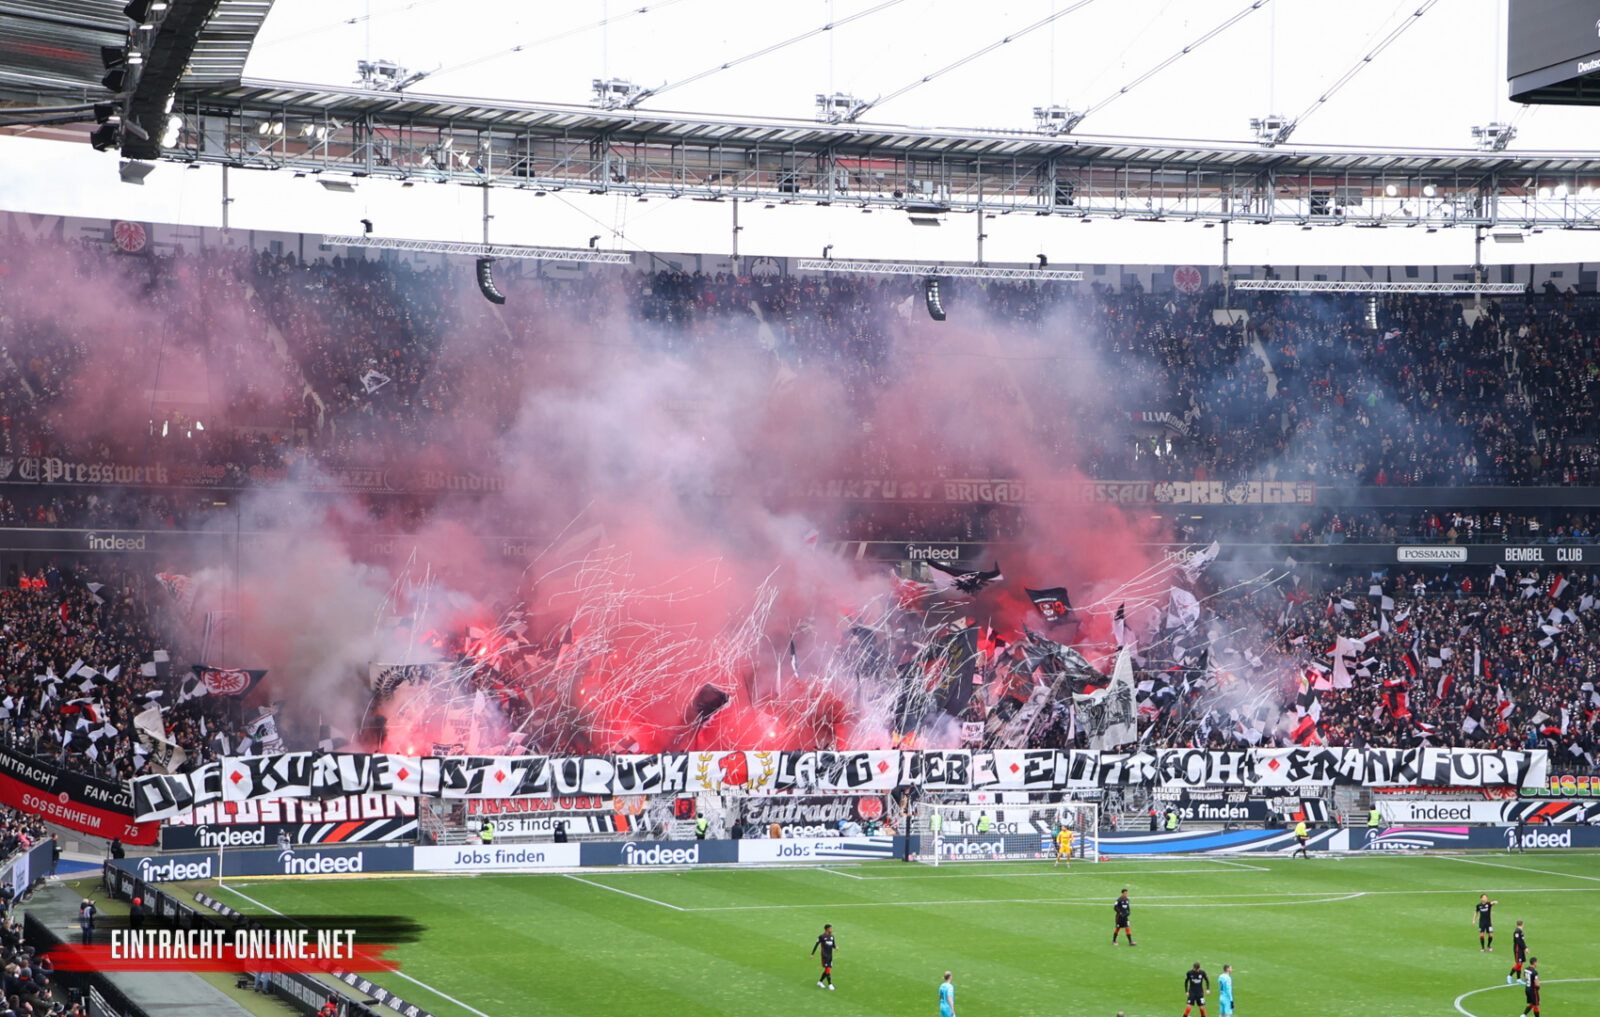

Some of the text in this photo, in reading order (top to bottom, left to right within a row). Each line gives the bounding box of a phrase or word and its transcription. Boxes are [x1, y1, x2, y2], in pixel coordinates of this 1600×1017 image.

[86, 532, 146, 550] indeed
[906, 543, 960, 560] indeed
[1404, 550, 1461, 559] POSSMANN
[1505, 547, 1582, 562] BEMBEL CLUB
[241, 752, 393, 799] KURVE
[421, 756, 496, 797] IST
[511, 752, 687, 797] ZURÜCK
[899, 751, 1000, 787] LEBE
[1286, 747, 1526, 786] FRANKFURT
[22, 793, 102, 829] SOSSENHEIM
[746, 796, 852, 825] Eintracht
[1198, 804, 1249, 819] finden
[1411, 804, 1471, 820] indeed
[124, 824, 139, 838] 75
[195, 825, 265, 847] indeed
[766, 823, 826, 838] ideed
[621, 842, 699, 865] indeed
[776, 842, 810, 857] Jobs
[932, 836, 1005, 855] indeed
[278, 850, 363, 874] indeed
[454, 848, 545, 865] Jobs finden
[137, 857, 212, 883] indeed
